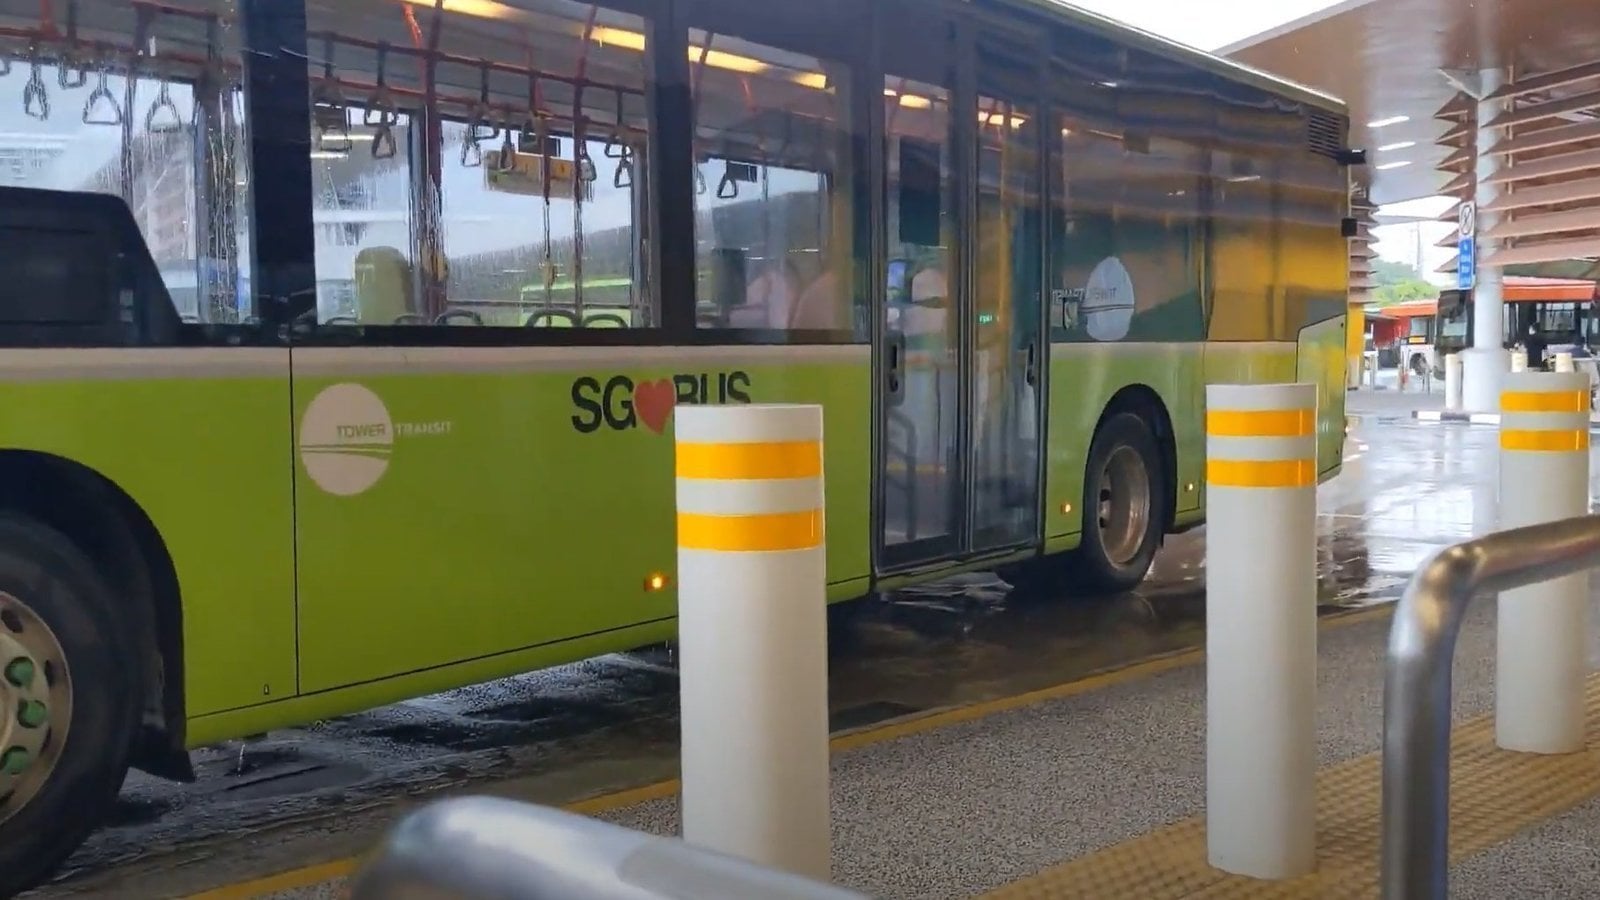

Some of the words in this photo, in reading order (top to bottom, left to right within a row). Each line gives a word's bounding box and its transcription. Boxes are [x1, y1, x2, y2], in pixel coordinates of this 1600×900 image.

[571, 375, 637, 433] SG
[673, 371, 751, 404] BUS
[336, 423, 386, 438] TOWER
[396, 420, 452, 436] TRANSIT
